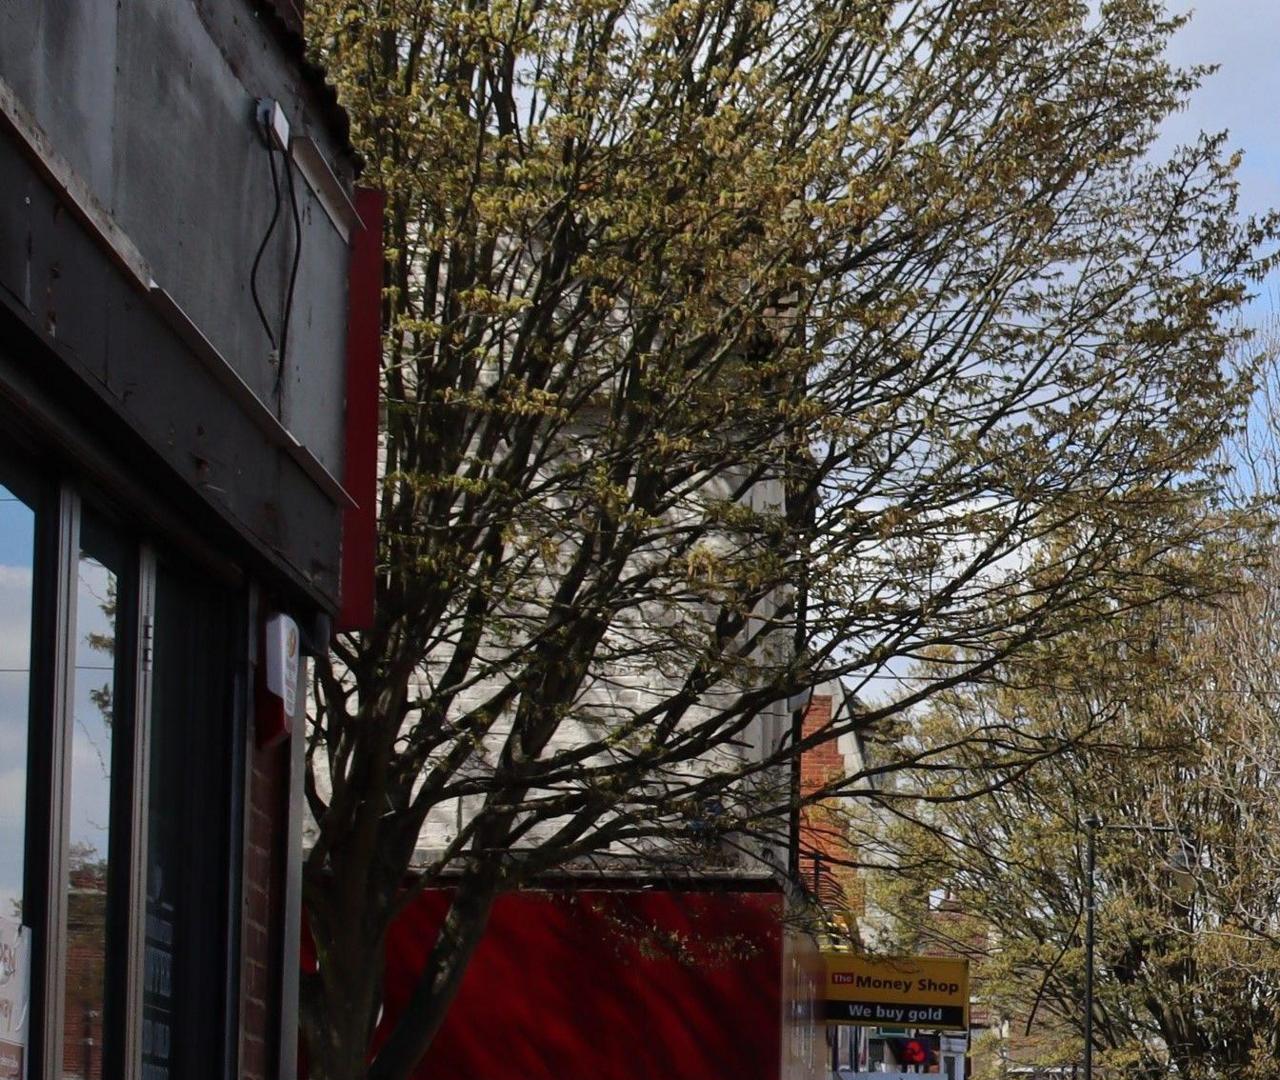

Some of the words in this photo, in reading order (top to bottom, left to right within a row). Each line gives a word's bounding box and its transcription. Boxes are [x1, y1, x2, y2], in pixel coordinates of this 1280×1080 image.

[833, 974, 852, 983] The
[856, 976, 912, 993] Money
[918, 979, 959, 995] Shop
[849, 1005, 871, 1017] We
[876, 1006, 905, 1020] buy
[908, 1008, 942, 1022] gold
